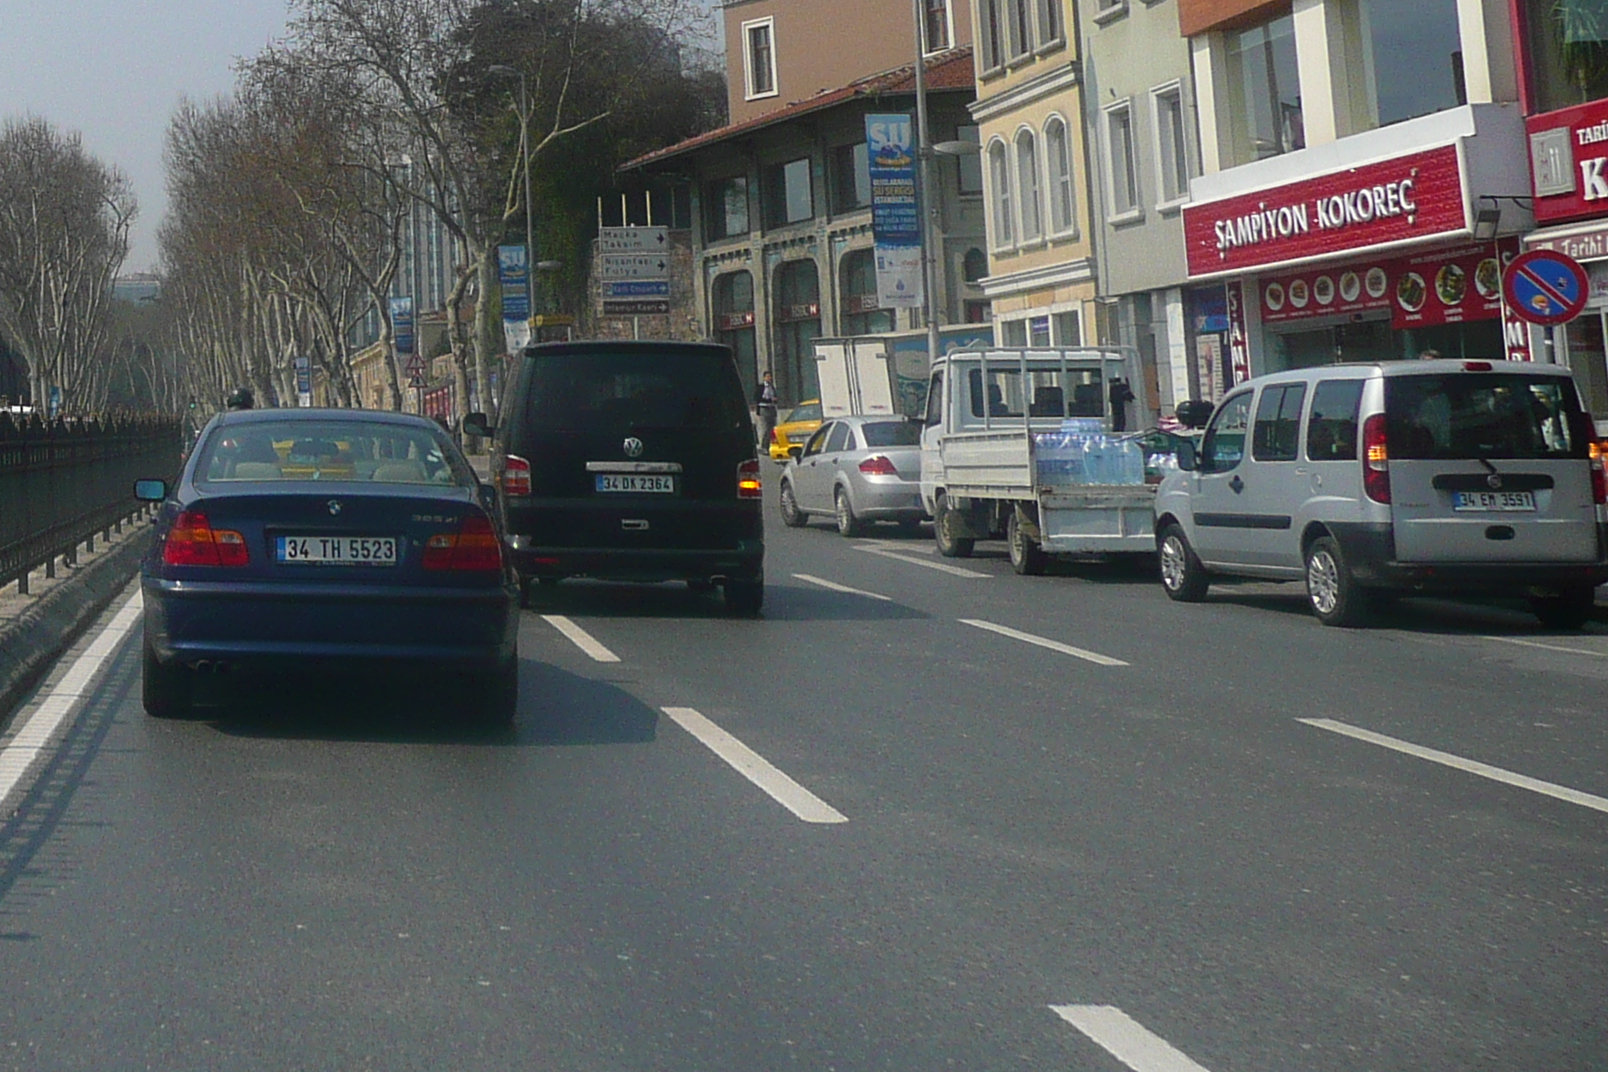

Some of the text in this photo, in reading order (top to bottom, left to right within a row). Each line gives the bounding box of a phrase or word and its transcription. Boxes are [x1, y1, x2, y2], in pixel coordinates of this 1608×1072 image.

[870, 122, 912, 152] SU
[1215, 178, 1417, 260] ŞAMPİYON KOKOREÇ
[1561, 234, 1602, 258] Tarihi
[604, 477, 671, 491] 34 DK 2364
[1459, 493, 1475, 506] 34
[1500, 493, 1531, 507] 3591
[288, 539, 394, 560] 34 TH 5523
